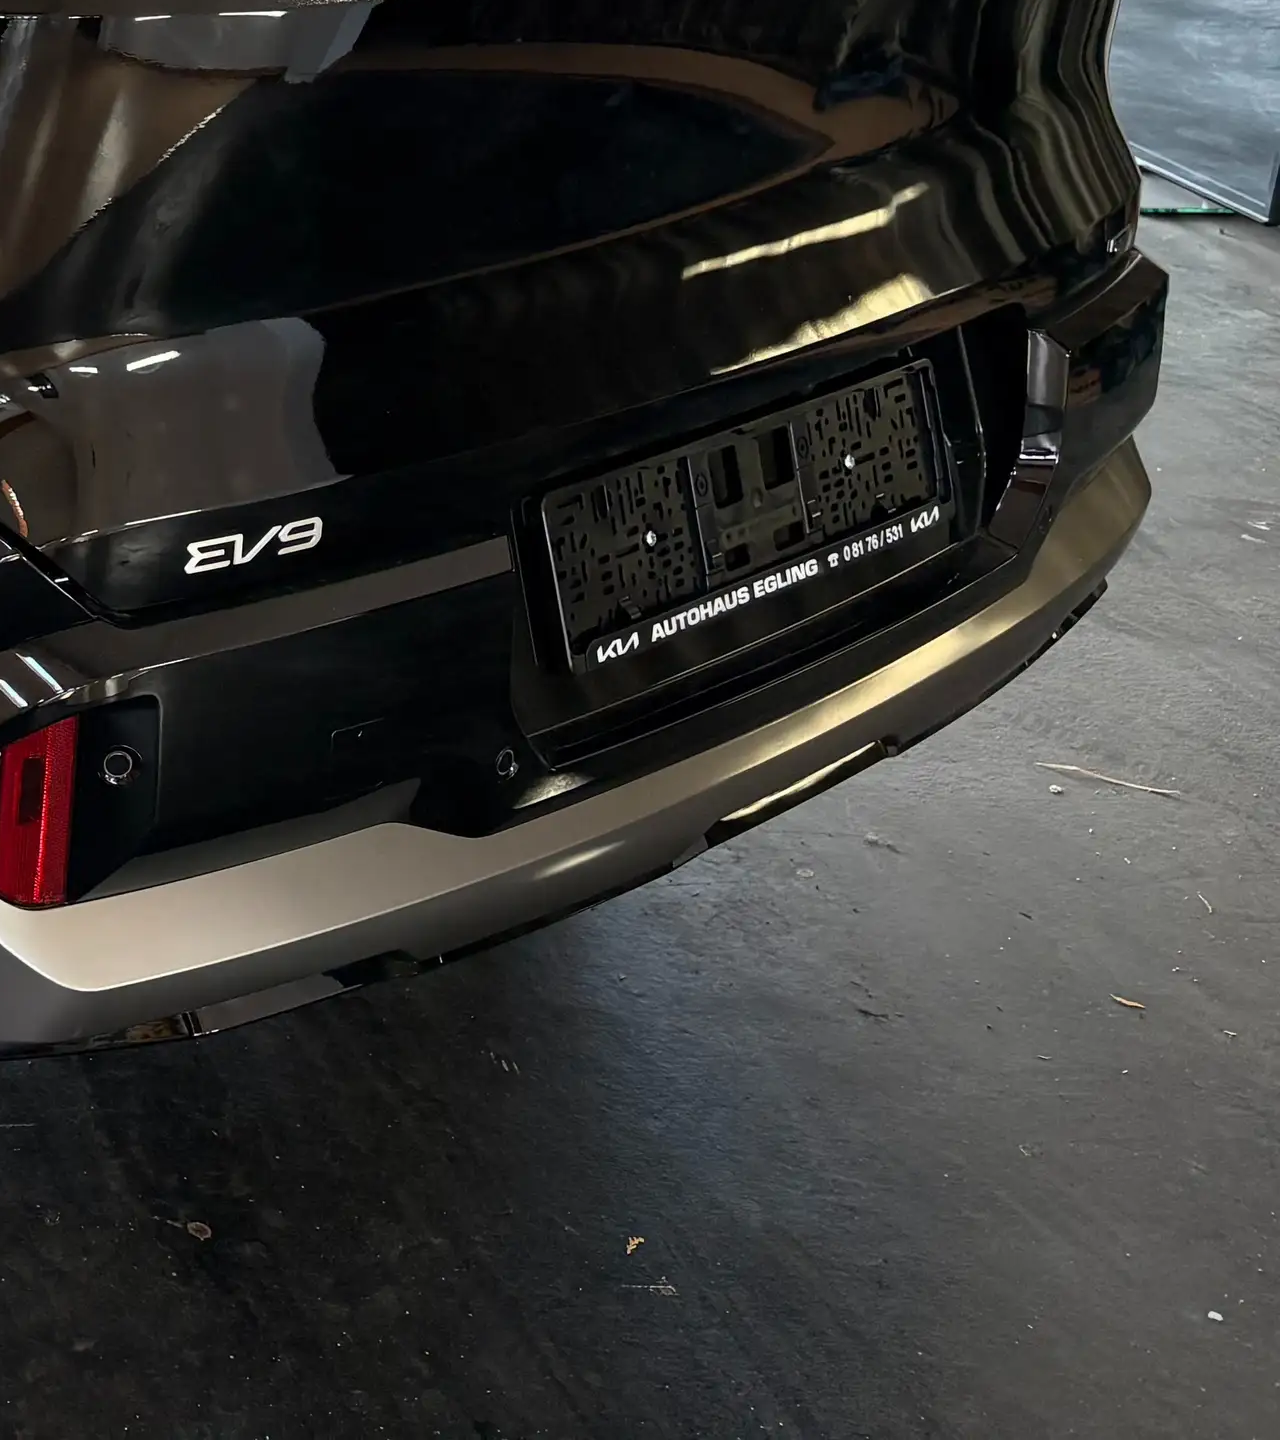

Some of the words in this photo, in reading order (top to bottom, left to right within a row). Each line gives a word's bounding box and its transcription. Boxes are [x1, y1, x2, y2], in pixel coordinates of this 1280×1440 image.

[184, 516, 323, 574] EV9
[596, 631, 640, 663] KIA
[651, 586, 750, 642] AUTOHAUS
[752, 558, 819, 599] EGLING
[910, 505, 940, 532] KIA
